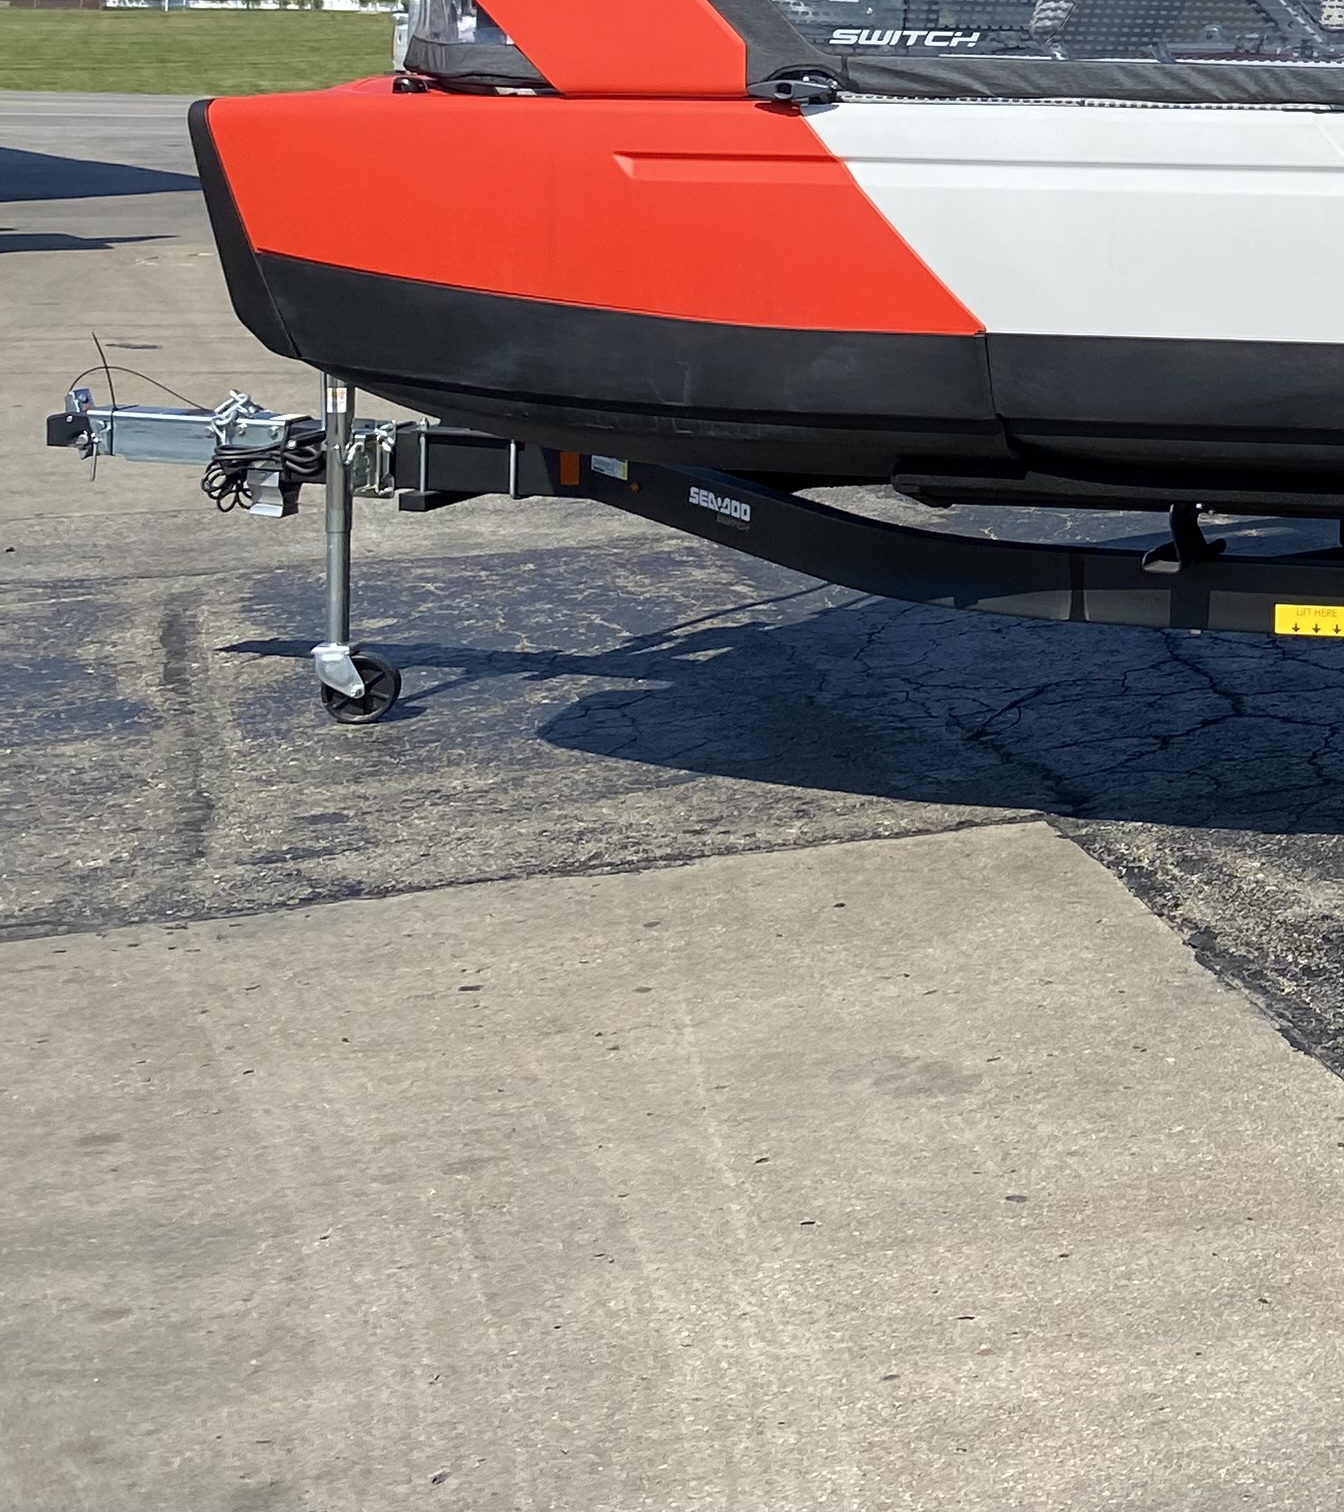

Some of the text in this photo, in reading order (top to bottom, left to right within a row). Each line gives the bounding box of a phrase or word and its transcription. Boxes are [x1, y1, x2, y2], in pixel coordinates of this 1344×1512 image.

[829, 28, 980, 47] SWITCH
[1296, 607, 1338, 618] LIFT HERE
